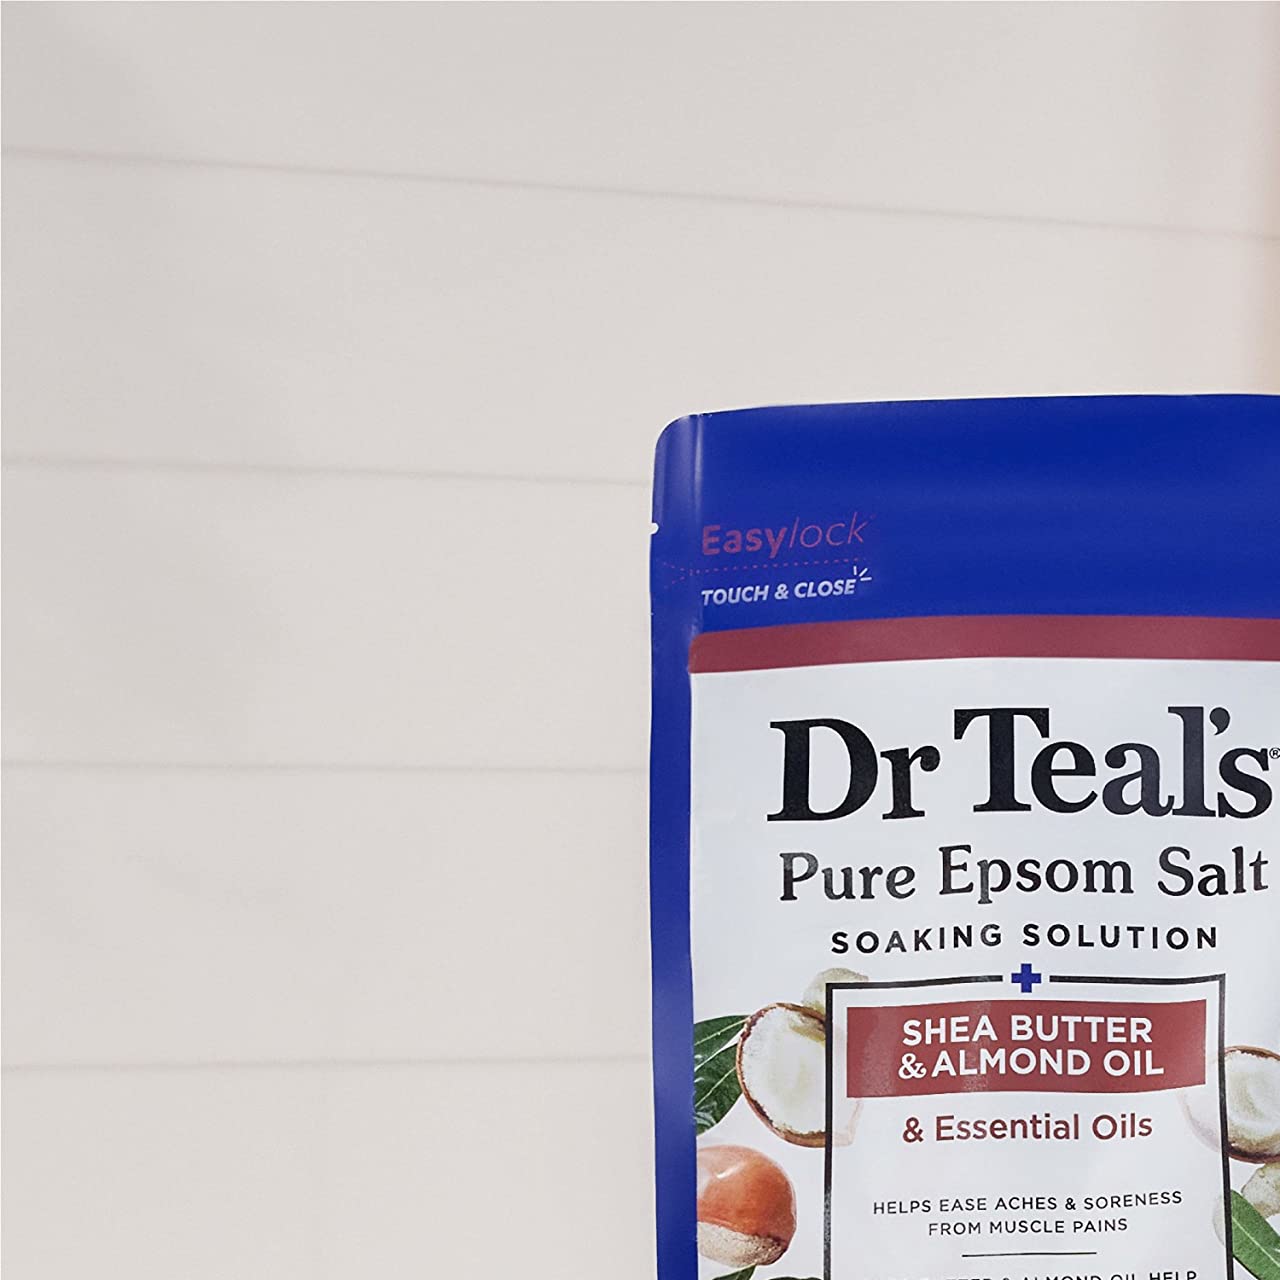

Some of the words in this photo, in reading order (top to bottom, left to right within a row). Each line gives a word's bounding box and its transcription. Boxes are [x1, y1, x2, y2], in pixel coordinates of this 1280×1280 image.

[702, 511, 869, 558] Easylock
[701, 584, 770, 606] TOUCH
[774, 583, 789, 600] &
[794, 578, 857, 599] CLOSE
[766, 718, 941, 822] Dr
[779, 852, 916, 902] Pure
[938, 844, 1135, 905] Epsom
[1157, 845, 1269, 897] Salt
[831, 923, 1002, 954] SOAKING
[1022, 923, 1217, 950] SOLUTION
[902, 1014, 998, 1047] SHEA
[1011, 1014, 1153, 1043] BUTTER
[1103, 1049, 1165, 1077] OIL
[902, 1116, 924, 1143] &
[935, 1112, 1079, 1142] Essential
[1092, 1112, 1153, 1140] Oils
[873, 1199, 932, 1215] HELPS
[939, 1197, 987, 1212] EASE
[994, 1196, 1058, 1211] ACHES
[1064, 1197, 1077, 1211] &
[1083, 1190, 1182, 1211] SORENESS
[928, 1222, 981, 1236] FROM
[989, 1219, 1065, 1234] MUSCLE
[1073, 1218, 1128, 1233] PAINS
